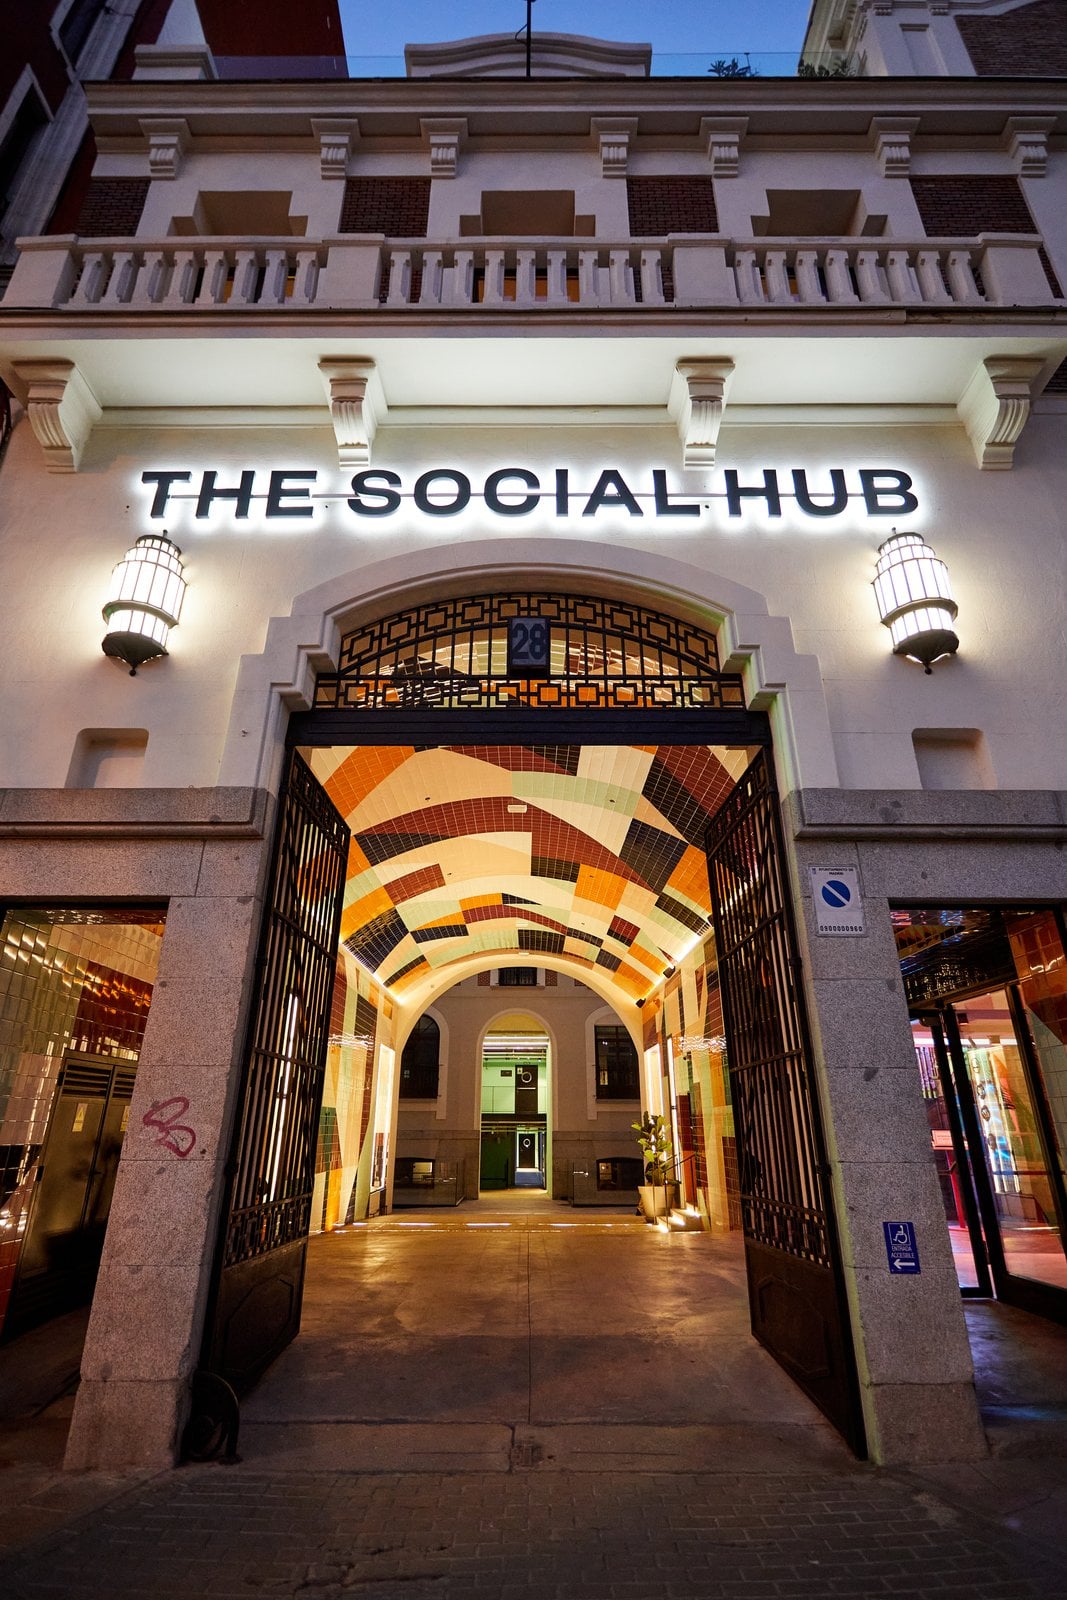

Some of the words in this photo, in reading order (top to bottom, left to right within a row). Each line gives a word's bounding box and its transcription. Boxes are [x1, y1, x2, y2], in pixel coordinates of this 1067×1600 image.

[141, 470, 317, 519] THE
[347, 469, 702, 519] SOCIAL
[725, 469, 918, 518] HUB
[512, 623, 546, 660] 28
